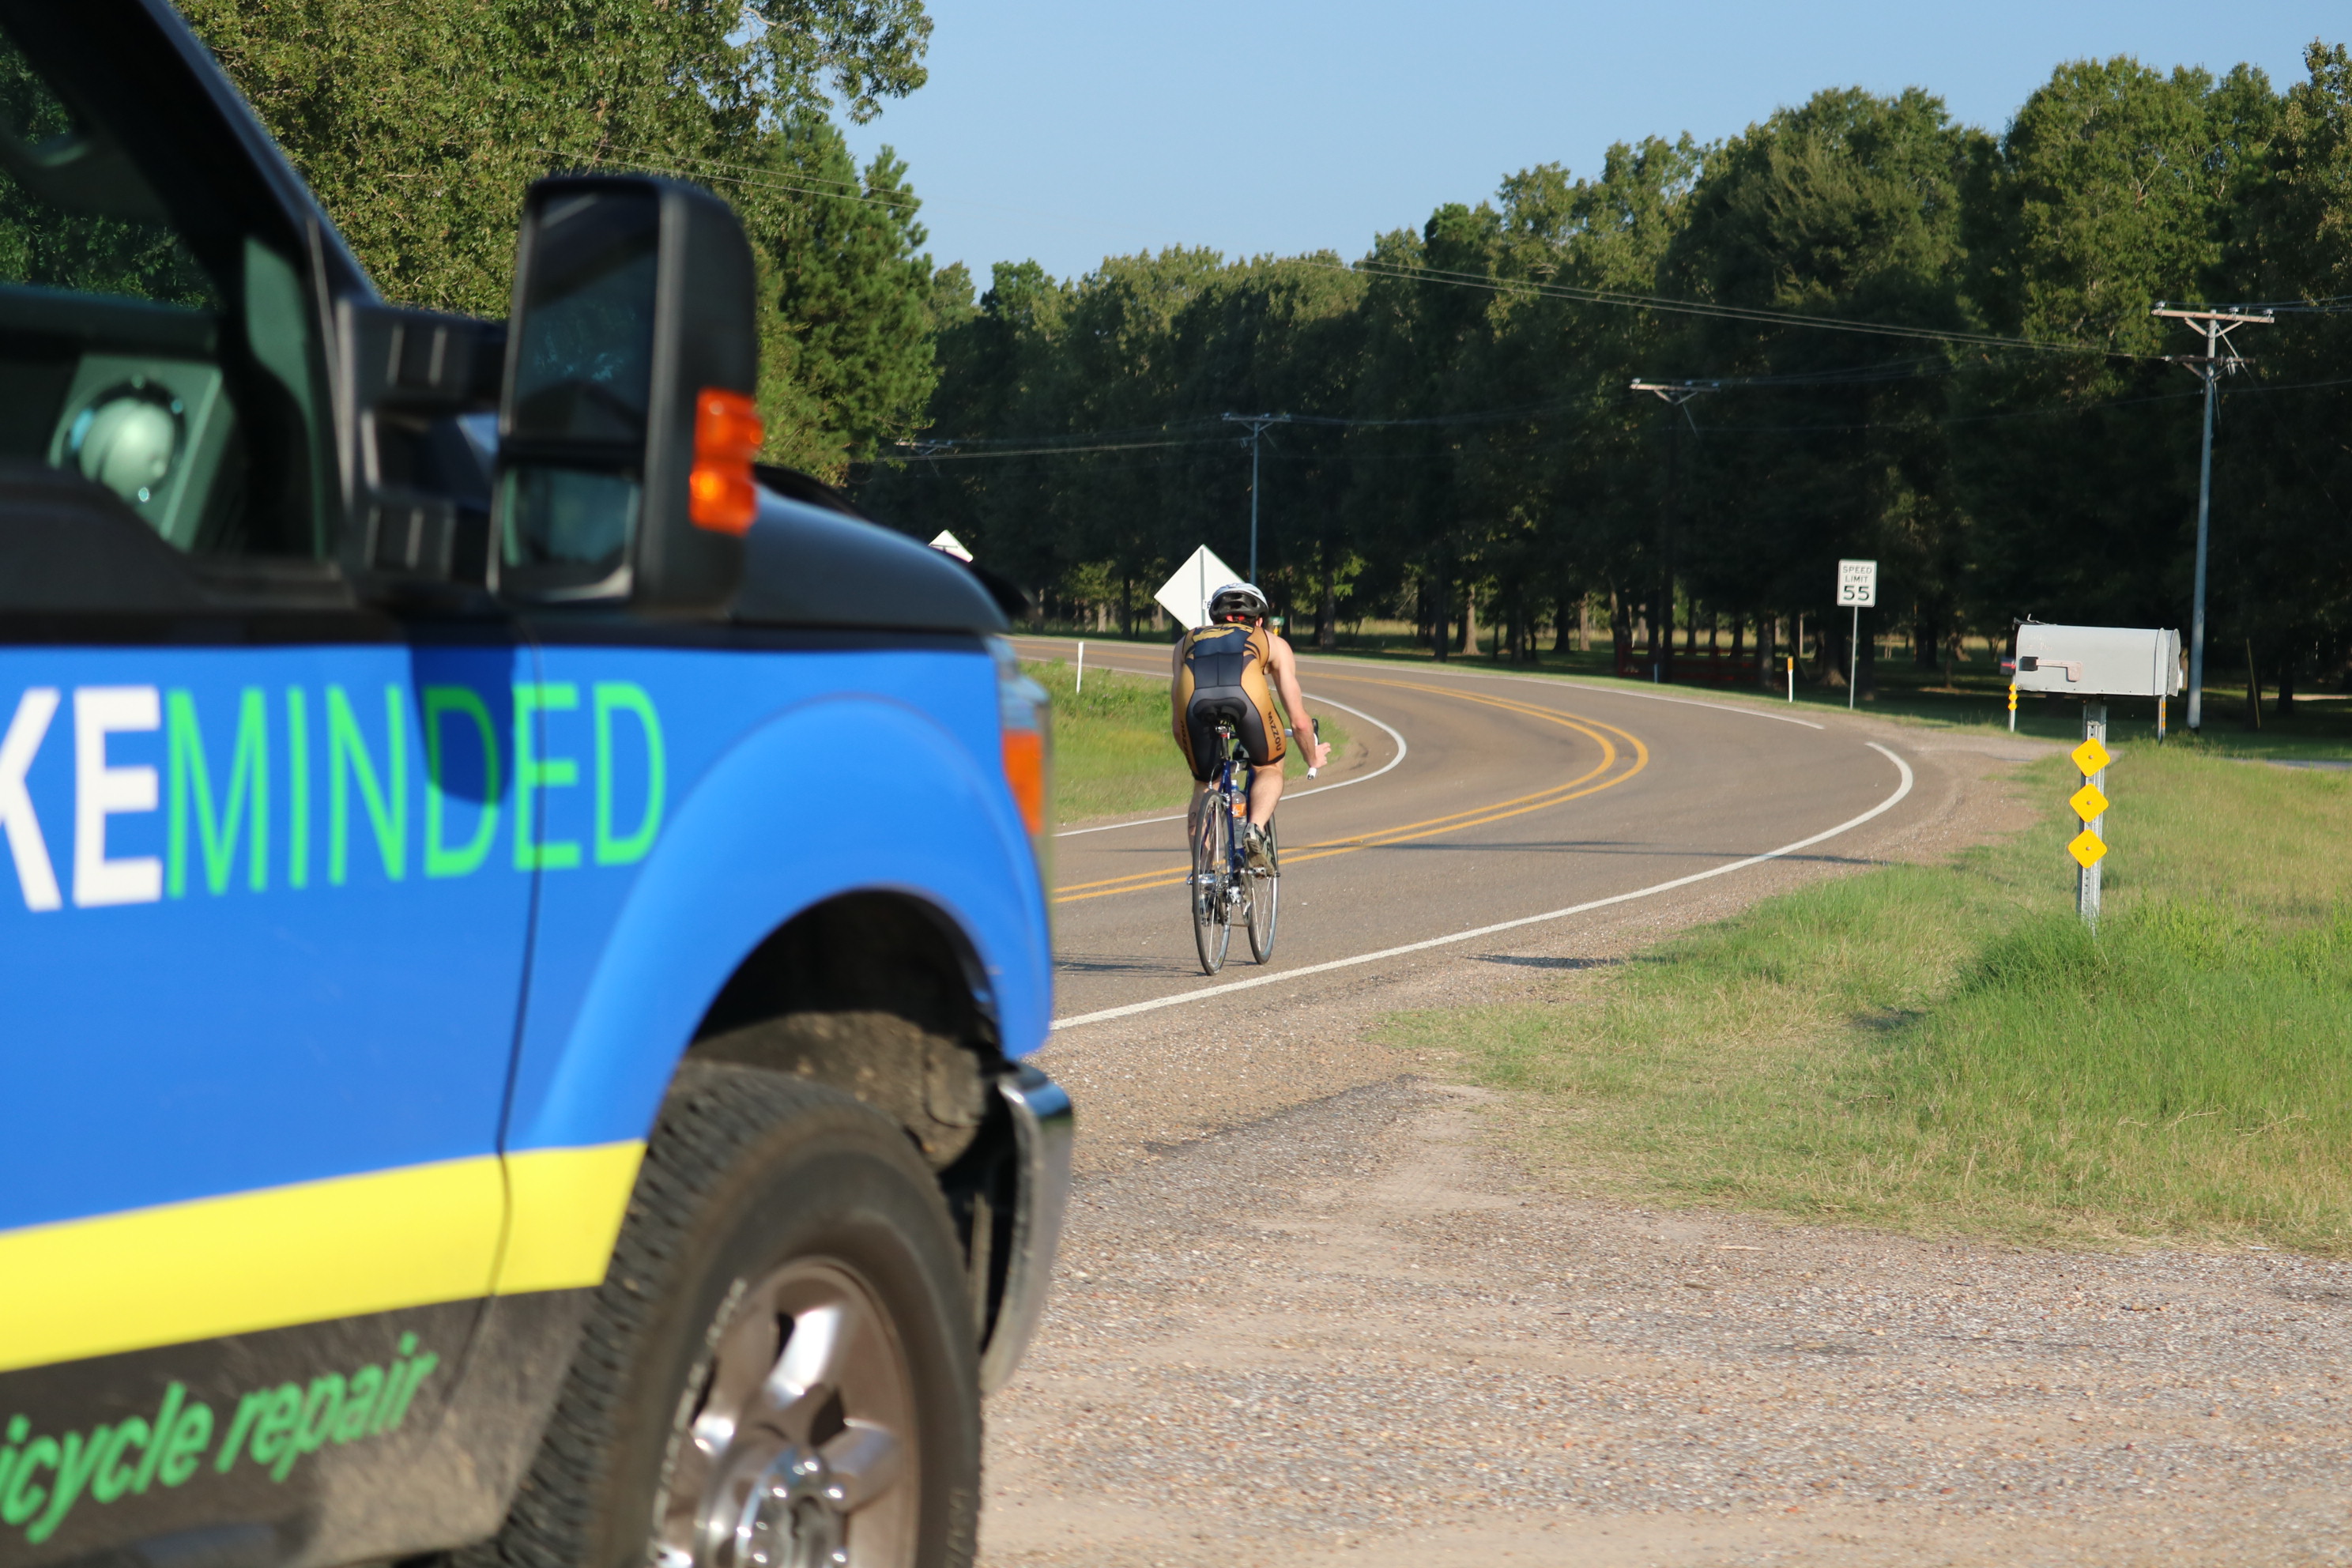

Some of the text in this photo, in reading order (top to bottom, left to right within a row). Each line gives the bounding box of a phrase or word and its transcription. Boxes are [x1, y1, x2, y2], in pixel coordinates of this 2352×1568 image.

[1842, 565, 1873, 575] SPEED
[1845, 575, 1868, 583] LIMIT
[1843, 585, 1870, 601] 55
[1268, 711, 1282, 752] MIZZOU
[214, 1331, 439, 1483] repair
